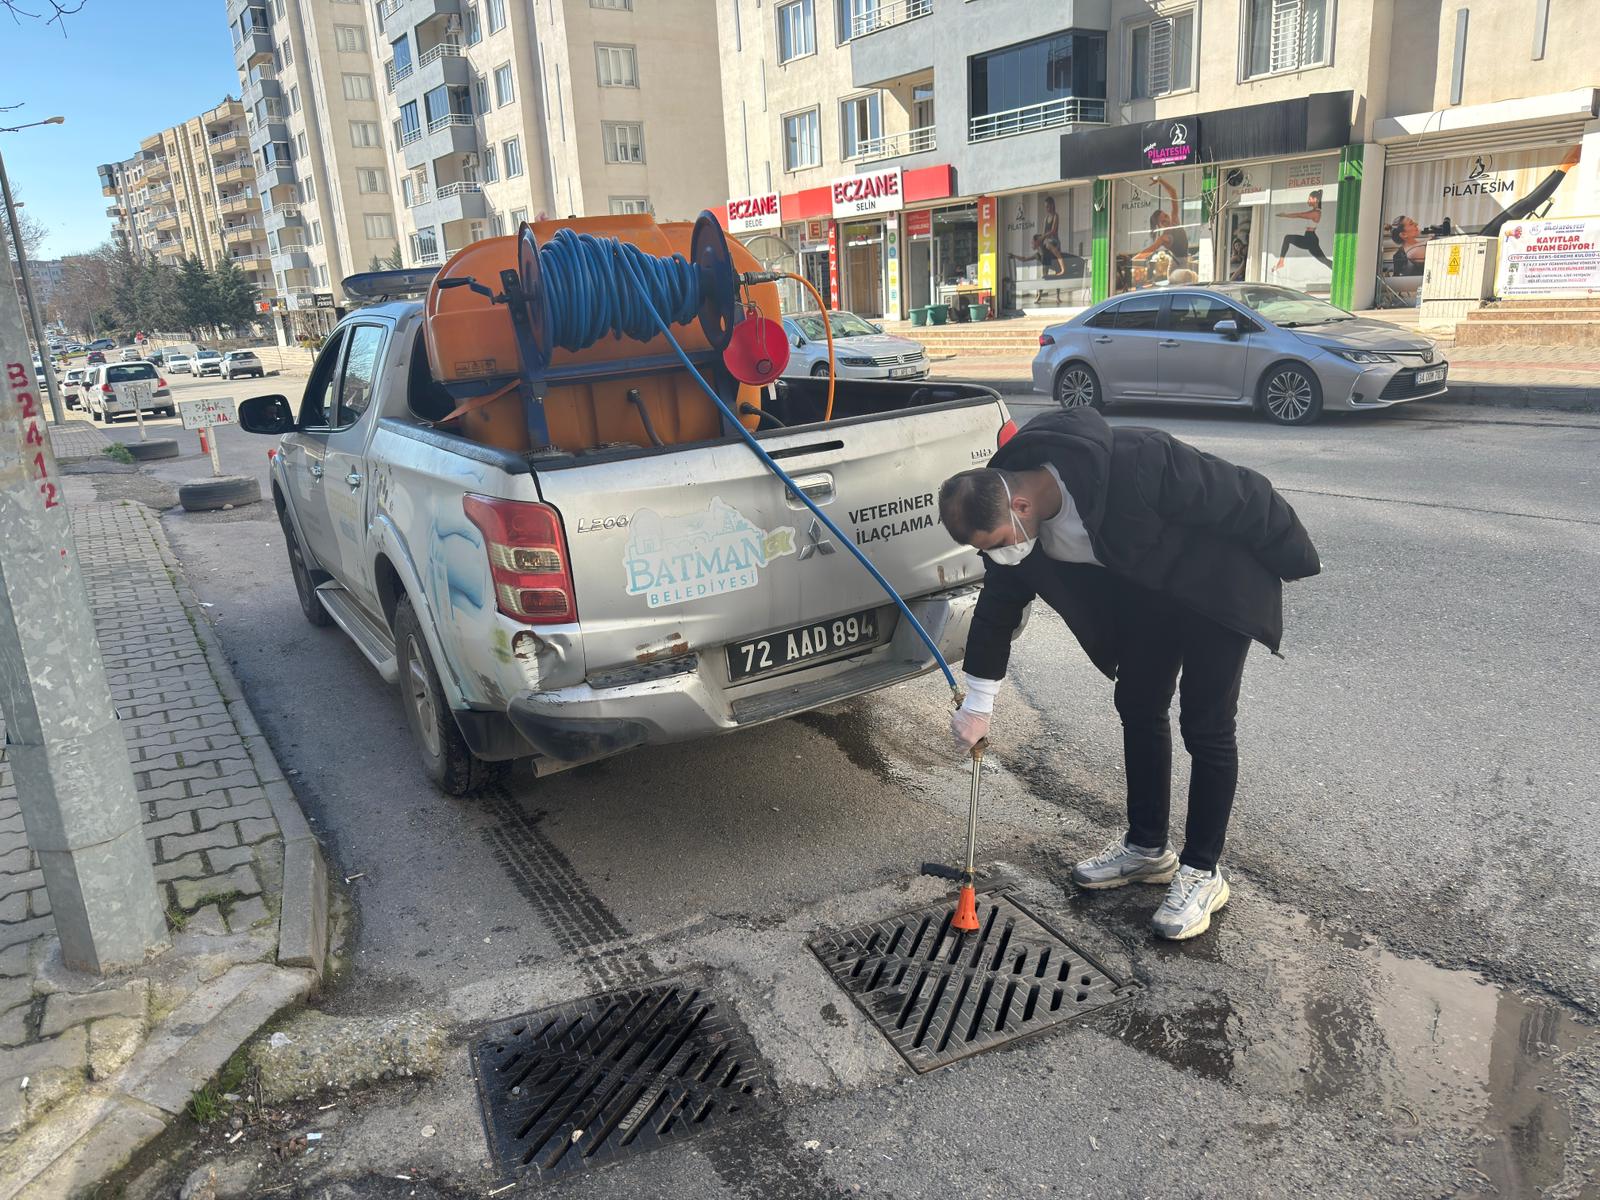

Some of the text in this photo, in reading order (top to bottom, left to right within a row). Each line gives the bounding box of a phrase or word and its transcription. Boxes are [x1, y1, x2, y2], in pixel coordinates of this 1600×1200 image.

[833, 172, 899, 204] ECZANE
[1443, 179, 1514, 198] PİLATESİM
[729, 194, 778, 220] ECZANE
[856, 200, 876, 212] SELİN
[745, 218, 763, 228] BELDE
[1526, 244, 1556, 252] DEVAM
[1557, 242, 1590, 251] EDİYOR
[1536, 235, 1580, 244] KAYITLAR
[828, 228, 838, 311] ECZAN
[848, 493, 934, 524] VETERİNER
[856, 514, 933, 545] İLAÇLAMA
[626, 534, 767, 593] BATMAN
[650, 571, 756, 605] BELEDİYESİ
[741, 613, 873, 672] 72 AAD 894
